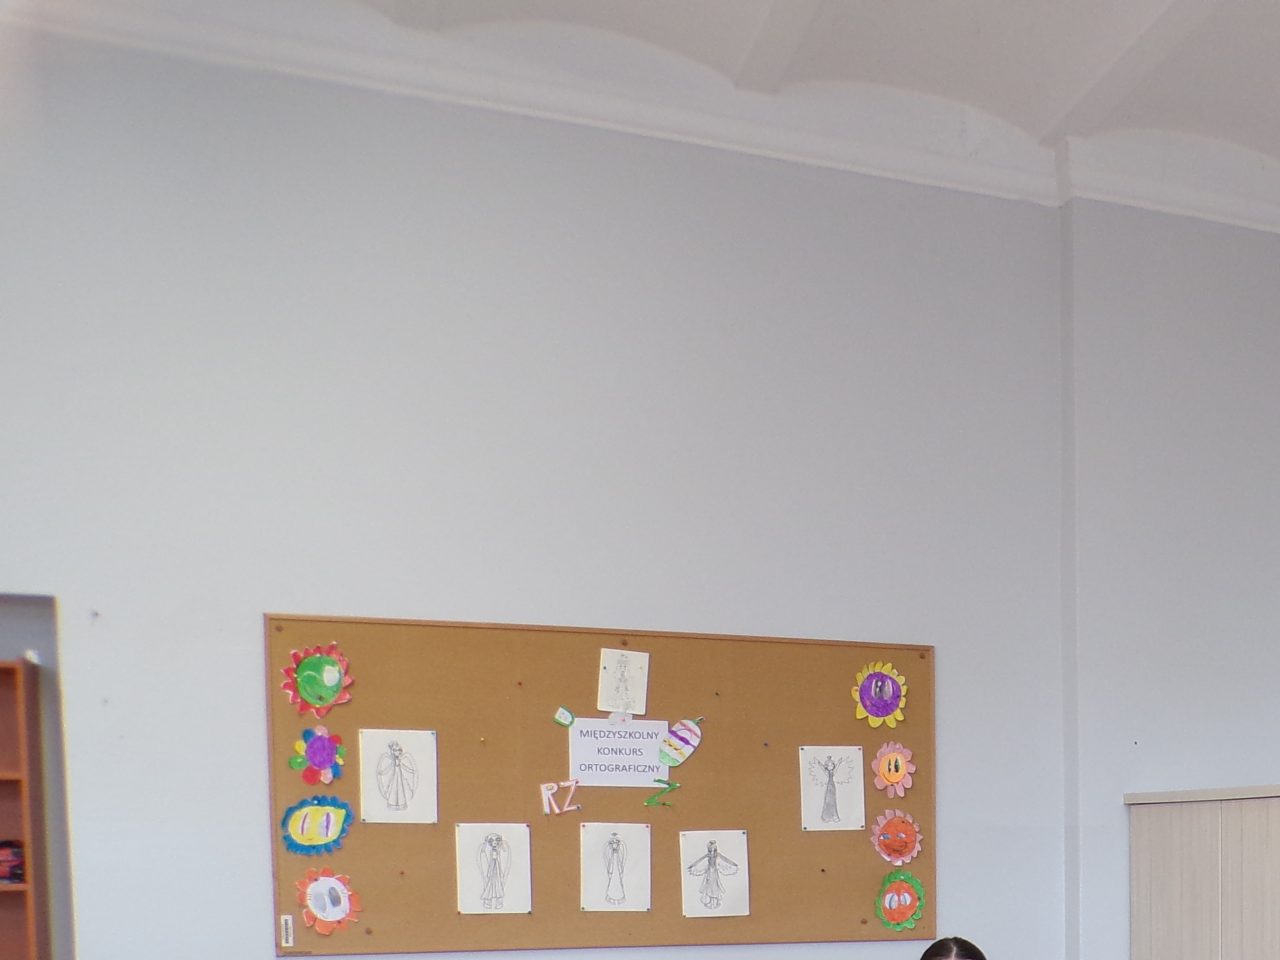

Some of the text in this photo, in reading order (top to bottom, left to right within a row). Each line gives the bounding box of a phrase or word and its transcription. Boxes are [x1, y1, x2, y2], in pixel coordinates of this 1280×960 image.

[579, 729, 660, 740] MIĘDZYSZKOLNY
[597, 747, 643, 757] KONKURS
[579, 763, 661, 773] ORTOGRAFICZNY
[540, 779, 581, 816] RZ
